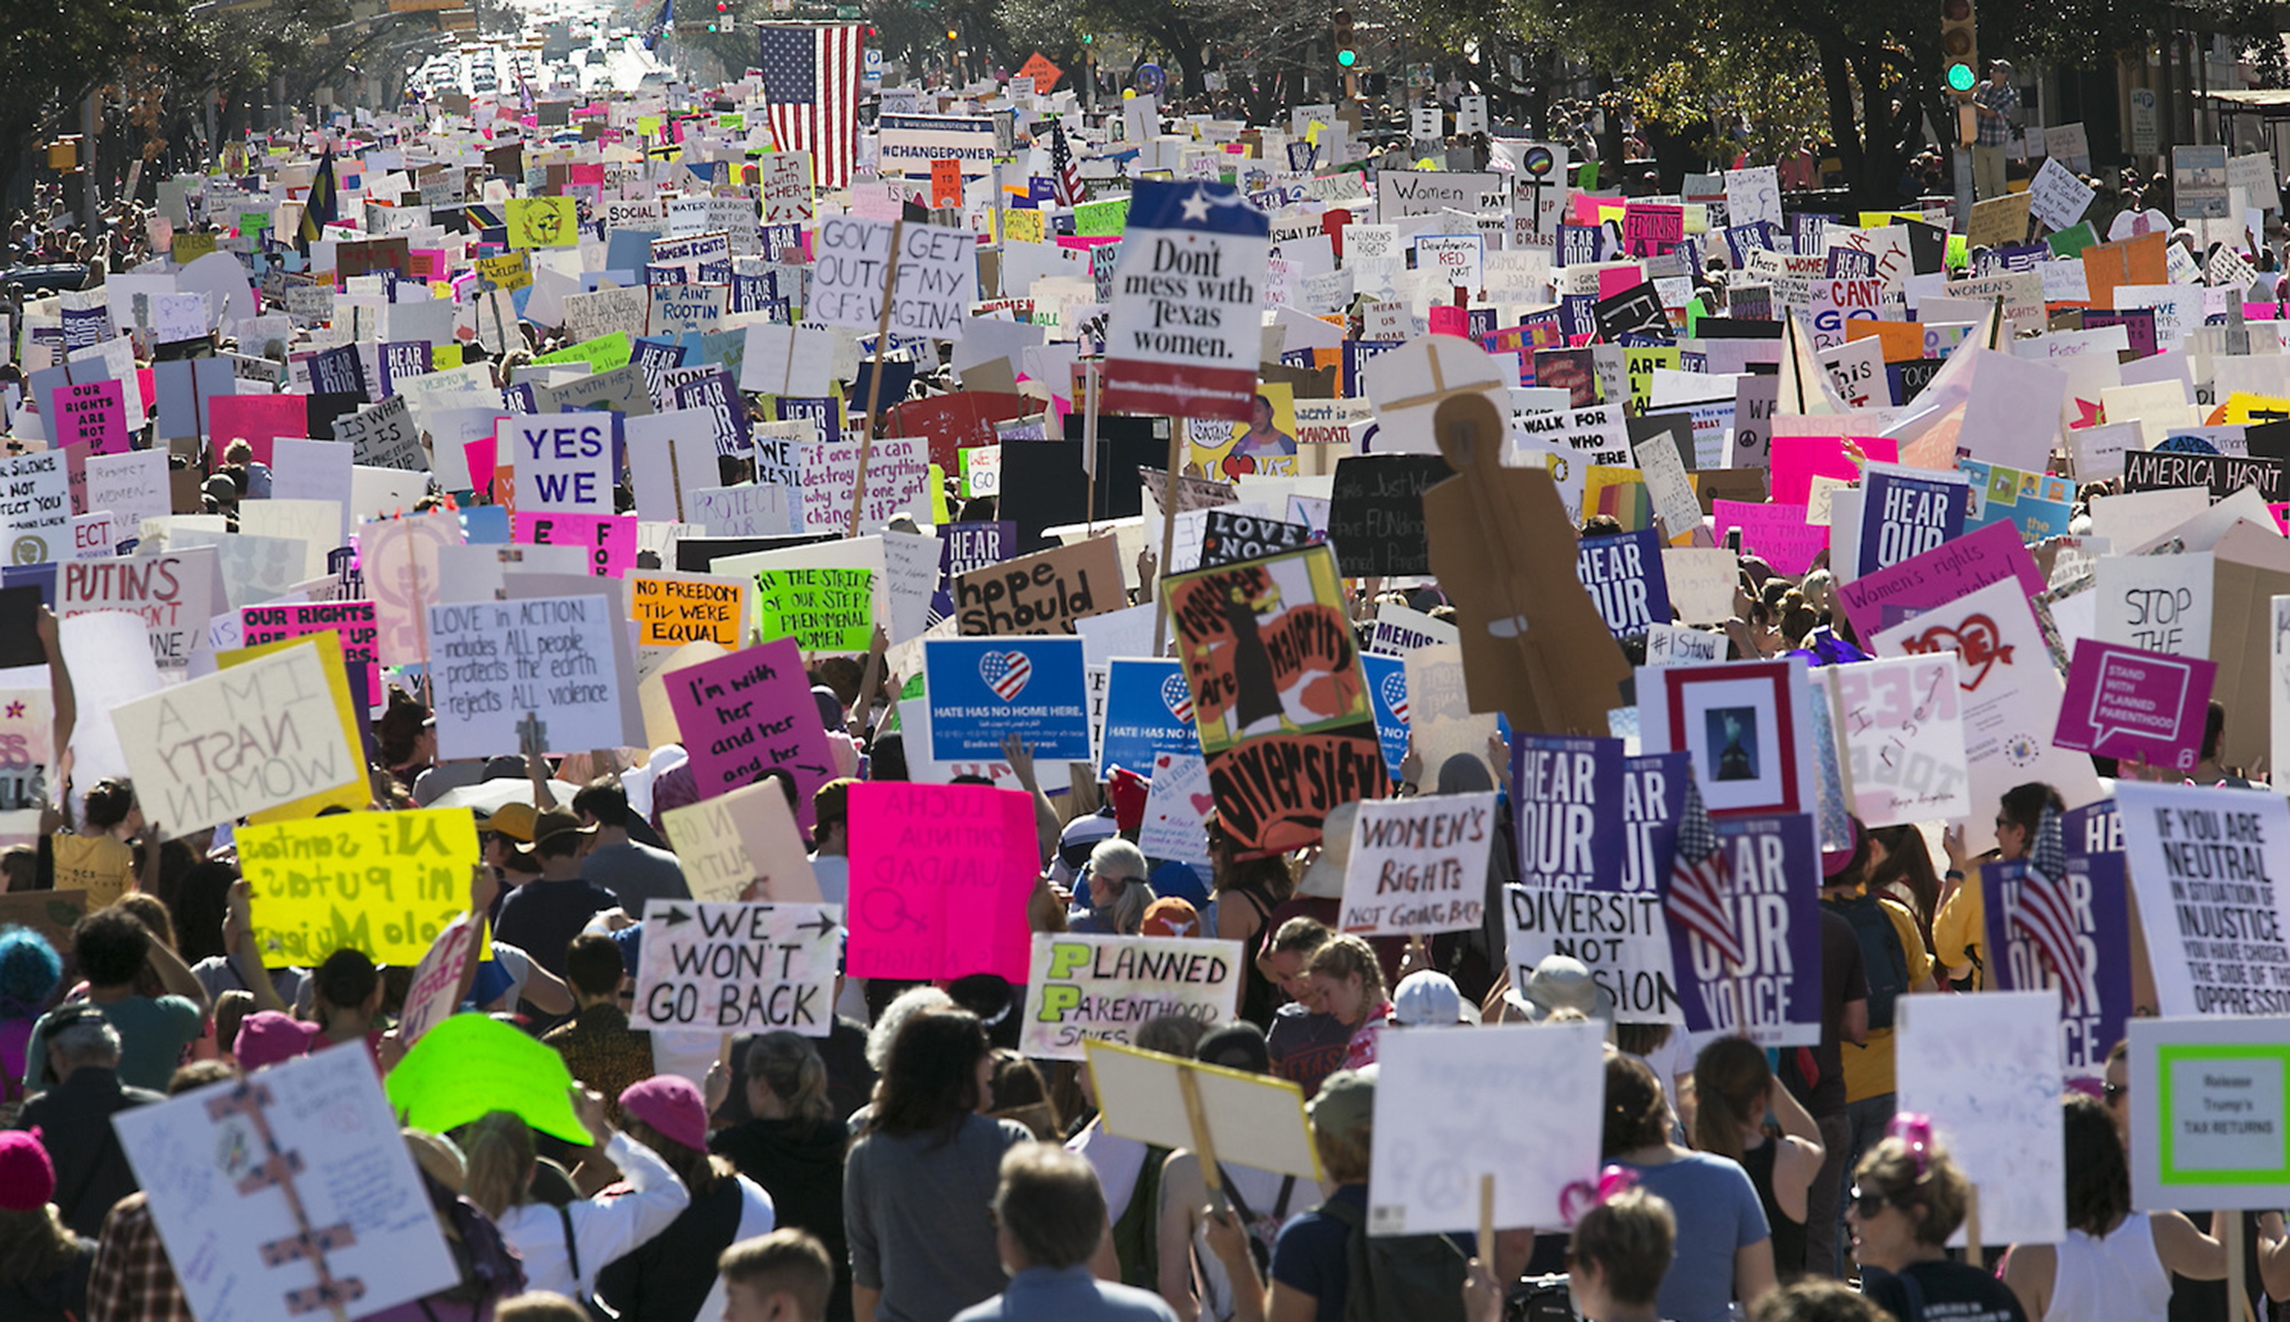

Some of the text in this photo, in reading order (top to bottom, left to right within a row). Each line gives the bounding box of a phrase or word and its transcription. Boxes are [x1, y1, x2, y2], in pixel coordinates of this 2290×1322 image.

[883, 145, 995, 160] #CHANGEPOWER
[776, 183, 802, 198] HER
[1393, 178, 1464, 200] Women
[1515, 186, 1534, 198] NOT
[671, 201, 707, 213] WATER
[1481, 194, 1507, 208] PAY
[1541, 200, 1555, 212] UP
[609, 205, 656, 221] SOCIAL
[1515, 218, 1534, 230] FOR
[907, 229, 974, 262] GET
[1516, 232, 1554, 246] GRABS
[1564, 230, 1594, 247] HEAR
[1731, 226, 1763, 247] HEAR
[1438, 252, 1466, 266] RED
[1836, 252, 1870, 274] HEAR
[817, 254, 963, 296] OUT MY
[654, 286, 677, 300] WE
[740, 279, 772, 296] HEAR
[1124, 274, 1254, 304] mess with
[1948, 280, 2014, 297] WOMEN'S
[662, 304, 719, 320] ROOTIN
[1149, 299, 1222, 329] Texas
[1372, 302, 1403, 311] HEAR
[318, 352, 354, 376] HEAR
[387, 347, 423, 368] HEAR
[639, 348, 677, 371] HEAR
[610, 369, 634, 386] HER
[72, 384, 101, 397] OUR
[683, 382, 728, 410] HEAR
[65, 398, 114, 413] RIGHTS
[366, 395, 405, 425] WHAT
[78, 413, 106, 425] ARE
[1523, 410, 1608, 434] WALK FOR
[78, 425, 106, 438] NOT
[374, 423, 402, 444] IS
[523, 426, 603, 459] YES
[1569, 434, 1605, 450] WHO
[757, 438, 791, 466] WE
[829, 442, 913, 462] one can
[803, 465, 855, 487] destroy
[972, 471, 995, 489] GO
[2127, 455, 2283, 493] AMERICA HASN'T
[10, 481, 36, 497] NOT
[535, 472, 597, 504] WE
[804, 476, 924, 510] why one girl
[1883, 486, 1949, 529] HEAR
[1215, 513, 1299, 546] LOVE
[2026, 517, 2051, 533] the
[950, 522, 1001, 561] HEAR
[1577, 543, 1644, 584] HEAR
[66, 558, 181, 602] PUTIN'S
[784, 569, 880, 592] THE STRIDE
[956, 562, 1056, 608] hope
[1844, 544, 1985, 611] Women's rights
[636, 581, 738, 602] NO FREEDOM
[763, 592, 871, 613] OF OUR STEP!
[244, 605, 375, 627] OUR RIGHTS
[431, 599, 586, 636] LOVE in ACTION
[2125, 587, 2193, 626] STOP
[780, 610, 869, 632] PHENOMENAL
[350, 628, 377, 644] UP
[504, 626, 585, 661] ALL people
[652, 622, 734, 645] EQUAL
[795, 630, 844, 649] WOMEN
[2131, 628, 2184, 657] THE
[515, 652, 598, 680] the earth
[2107, 664, 2146, 681] STAND
[511, 679, 608, 711] ALL violence
[689, 664, 777, 706] I'm with
[2105, 679, 2136, 694] WITH
[715, 700, 754, 725] her
[934, 706, 1084, 718] HATE HAS NO HOME HERE.
[2101, 693, 2157, 713] PLANNED
[2099, 707, 2176, 731] PARENTHOOD
[711, 715, 795, 756] and her
[1108, 726, 1186, 739] HATE HAS NO
[1879, 704, 1927, 768] rise
[723, 743, 800, 783] and her
[1522, 750, 1596, 804] HEAR
[1361, 804, 1486, 850] WOMEN'S
[2154, 808, 2266, 845] IF YOU ARE
[1522, 803, 1596, 874] OUR
[2161, 842, 2274, 883] NEUTRAL
[2170, 880, 2186, 899] IN
[697, 905, 774, 940] WE
[1344, 900, 1445, 929] NOT GOING
[2174, 904, 2285, 943] INJUSTICE
[671, 943, 802, 981] WON'T
[1554, 938, 1625, 963] NOT
[2182, 941, 2242, 962] YOU HAVE
[1048, 942, 1227, 984] PLANNED
[2187, 962, 2268, 985] THE SIDE OF
[648, 983, 820, 1028] GO BACK
[1037, 984, 1218, 1023] PARENTHOOD
[1700, 976, 1793, 1032] VOICE
[1055, 1025, 1129, 1047] SAVES
[2204, 1074, 2252, 1088] Release
[2203, 1097, 2253, 1114] Trump's
[2184, 1120, 2274, 1135] TAX RETURNS
